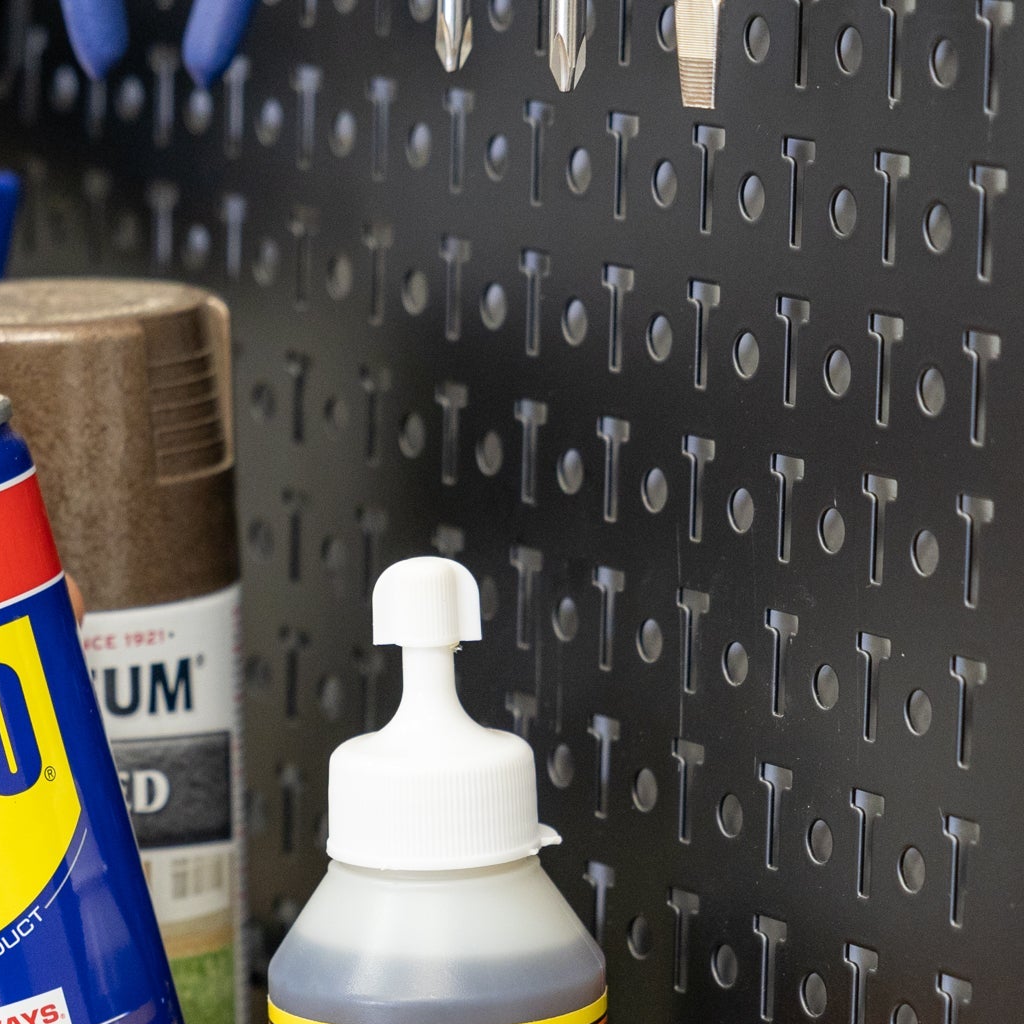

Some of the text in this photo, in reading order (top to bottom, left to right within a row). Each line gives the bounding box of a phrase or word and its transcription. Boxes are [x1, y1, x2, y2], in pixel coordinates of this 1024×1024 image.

[83, 629, 166, 651] NCE 1921
[103, 656, 194, 717] UM
